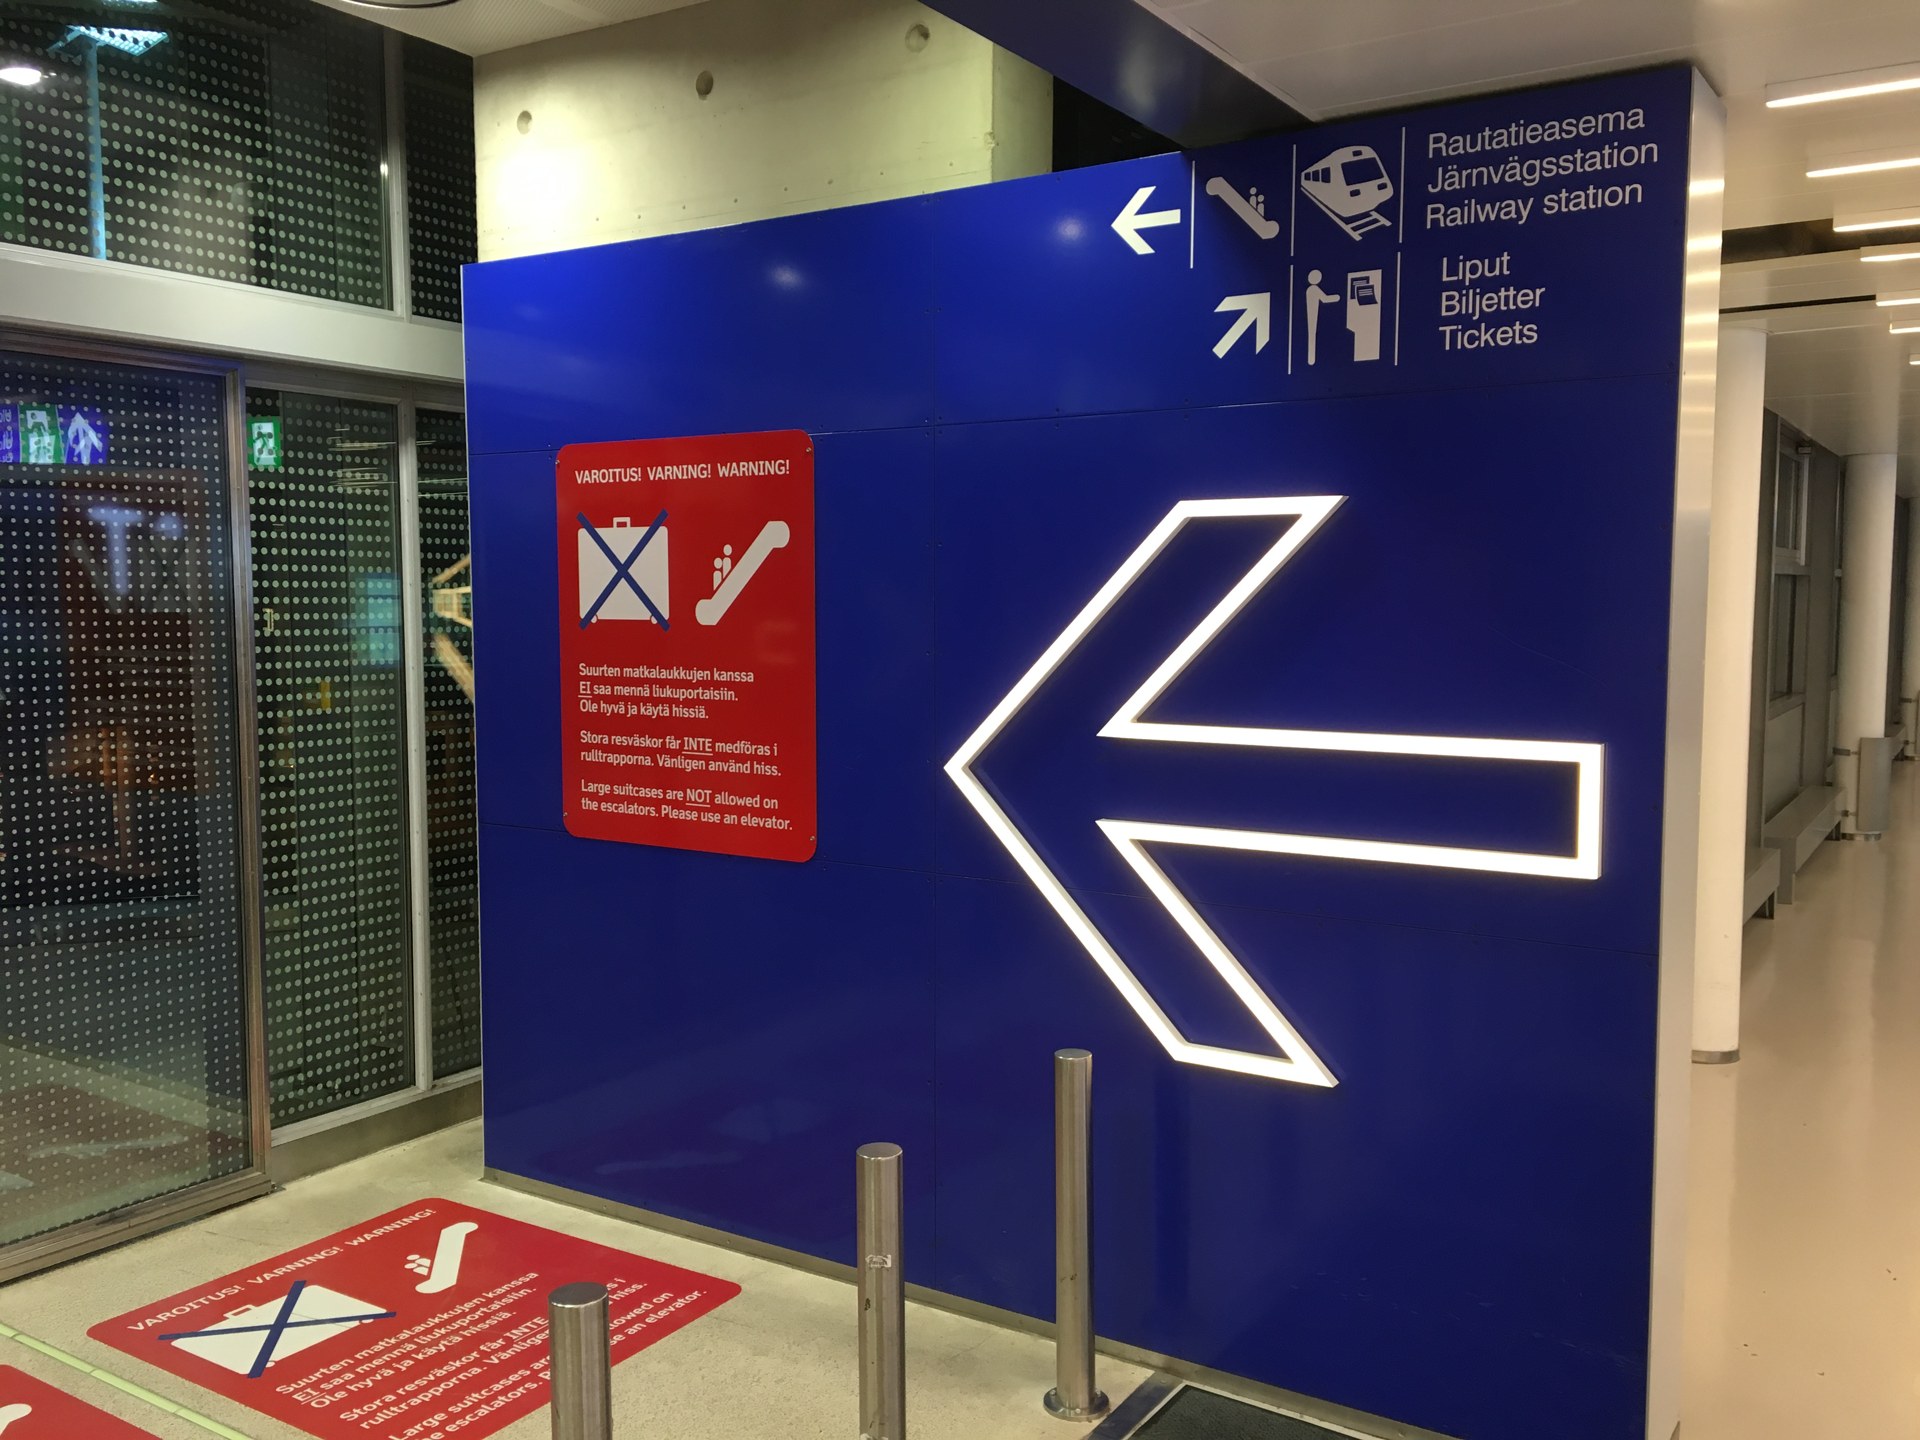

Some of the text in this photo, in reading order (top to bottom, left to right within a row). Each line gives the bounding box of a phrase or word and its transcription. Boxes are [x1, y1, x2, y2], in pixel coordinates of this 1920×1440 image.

[1428, 107, 1645, 158] Rautatieasema
[1427, 141, 1658, 193] Järnvägsstation
[1426, 182, 1643, 229] Railway station
[1441, 251, 1511, 286] Liput
[1440, 286, 1546, 320] Biljetter
[1438, 320, 1538, 350] Tickets
[574, 459, 790, 484] VAROITUS! VARNING! WARNING!
[578, 663, 754, 683] Suurten matkalaukkujen kanssa
[579, 681, 739, 701] EI saa mennä liukuportaisiin.
[579, 699, 709, 719] Ole hyvä ja käytä hissiä.
[580, 730, 778, 757] Stora resväskor får INTE medföras i
[580, 749, 782, 776] rulltrapporna. Vänligen använd hiss.
[581, 779, 779, 809] Large suitcases are NOT allowed on
[581, 797, 793, 831] the escalators. Please use an elevator.
[127, 1208, 436, 1331] VAROITUS! VARNING! WARNING!
[275, 1272, 539, 1394] Suurten matkalaukkujen kanssa
[292, 1288, 537, 1402] EI saa mennä liukuportaisiin.
[447, 1369, 531, 1413] suitcases
[529, 1355, 550, 1370] ar
[652, 1291, 674, 1303] on
[310, 1311, 517, 1408] Ole hyvä ja käytä hissiä.
[339, 1395, 397, 1421] Stora
[396, 1351, 481, 1395] resväskor
[479, 1338, 506, 1352] får
[503, 1316, 549, 1340] INTE
[360, 1366, 488, 1429] rulltrapporna.
[482, 1329, 549, 1364] Vänlige
[445, 1382, 543, 1432] escalators.
[624, 1323, 647, 1335] an
[645, 1290, 707, 1323] elevator.
